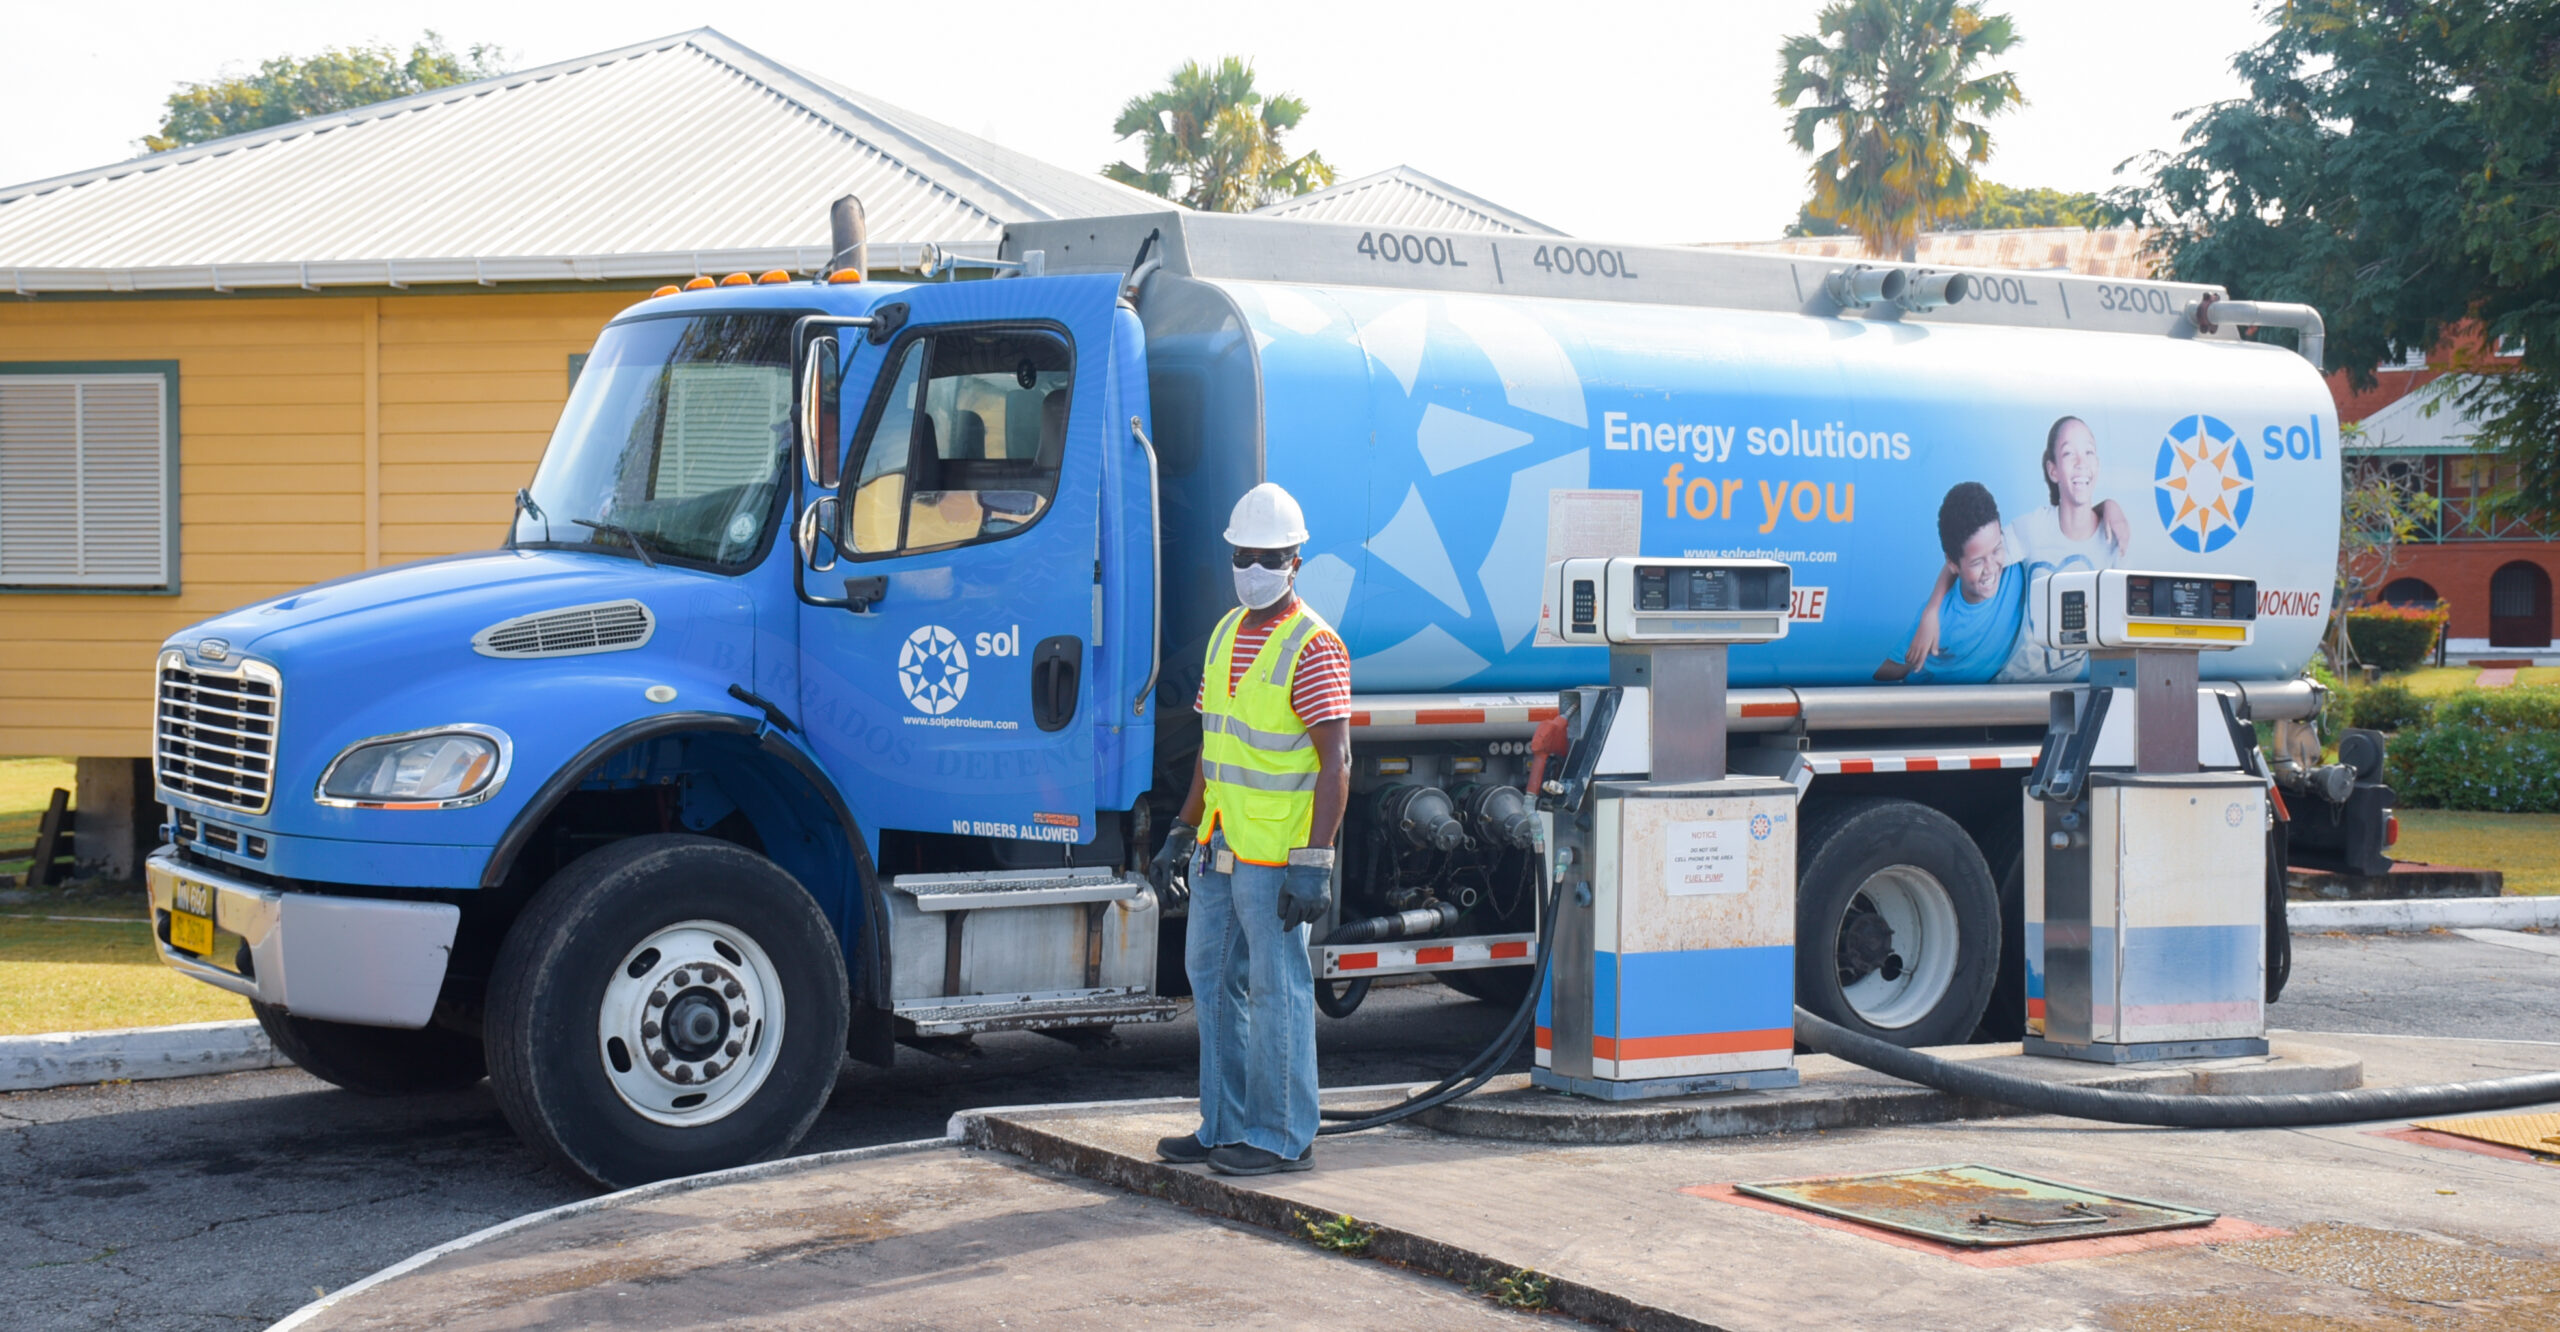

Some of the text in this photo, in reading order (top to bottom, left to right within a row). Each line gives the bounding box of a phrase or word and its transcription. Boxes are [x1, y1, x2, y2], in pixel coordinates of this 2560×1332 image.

[1357, 231, 1468, 267] 4000L
[1533, 245, 1638, 279] 4000L
[1966, 275, 2037, 306] 000L
[2098, 284, 2183, 316] 3200L
[1604, 411, 1911, 462] Energy solutions
[2263, 414, 2322, 461] sol
[1663, 462, 1855, 534] for you
[2256, 590, 2320, 617] MOKING
[975, 624, 1019, 657] sol
[903, 715, 1019, 730] www.solpetroleum.com
[952, 819, 1079, 843] NO RIDERS ALLOWED
[1691, 831, 1718, 840] NOTICE
[1684, 872, 1724, 883] FUEL PUMP
